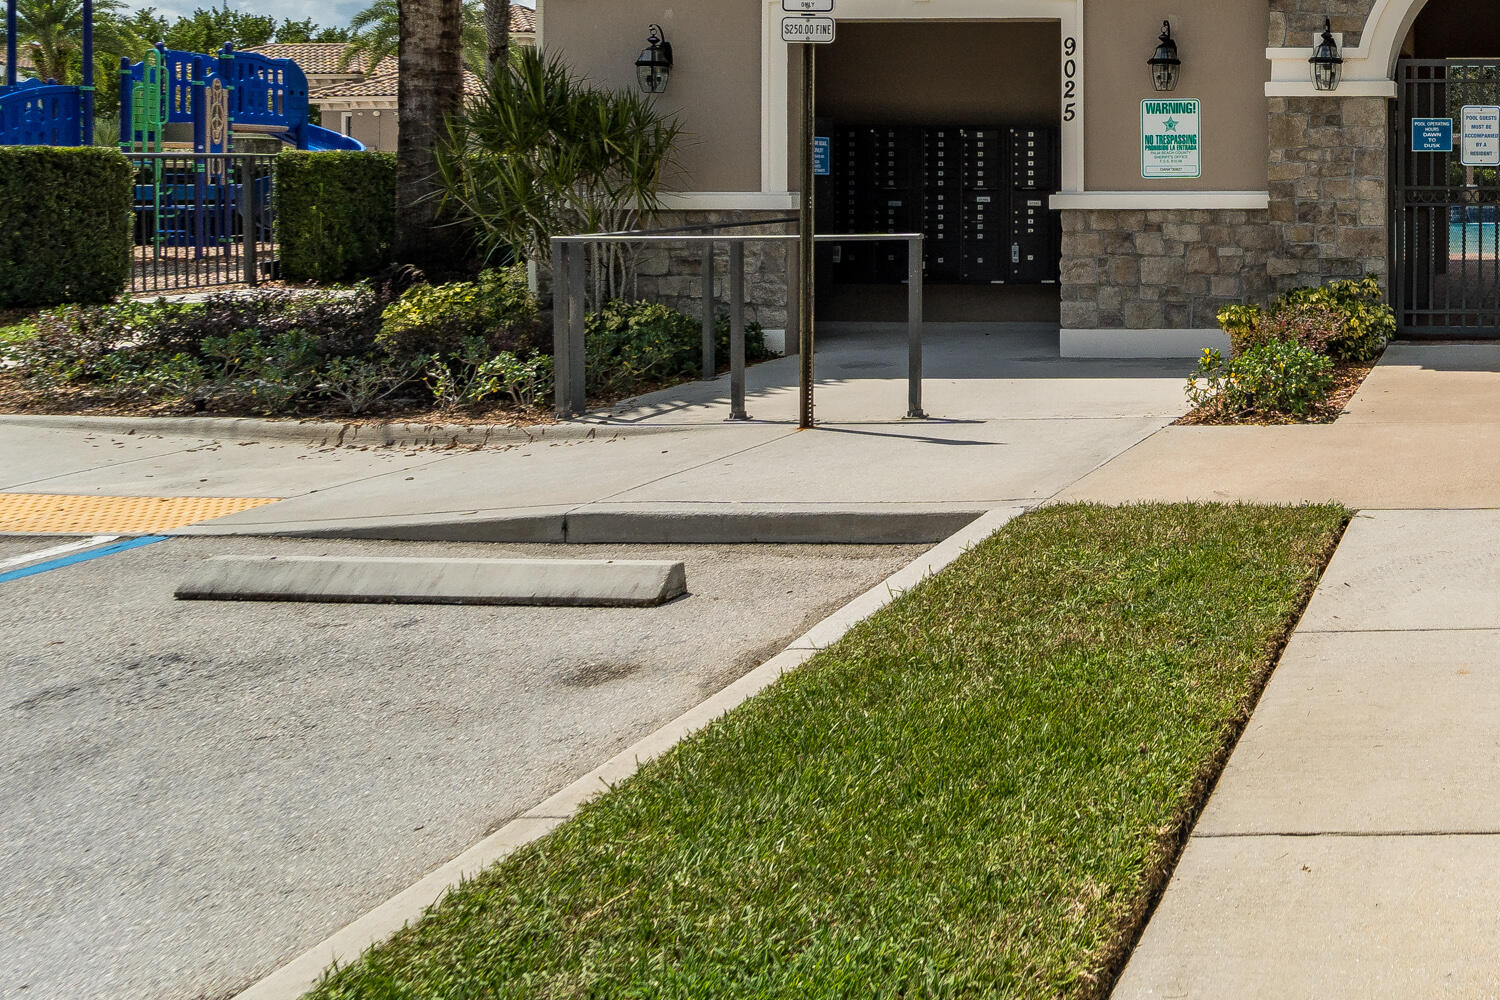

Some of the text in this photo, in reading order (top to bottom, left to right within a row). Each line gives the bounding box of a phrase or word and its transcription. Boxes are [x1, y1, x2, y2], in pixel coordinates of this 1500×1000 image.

[784, 24, 831, 34] $250.00 FINE
[1064, 36, 1076, 122] 9025
[1145, 102, 1196, 114] WARNING!
[1145, 134, 1197, 144] NO TRESPASSING
